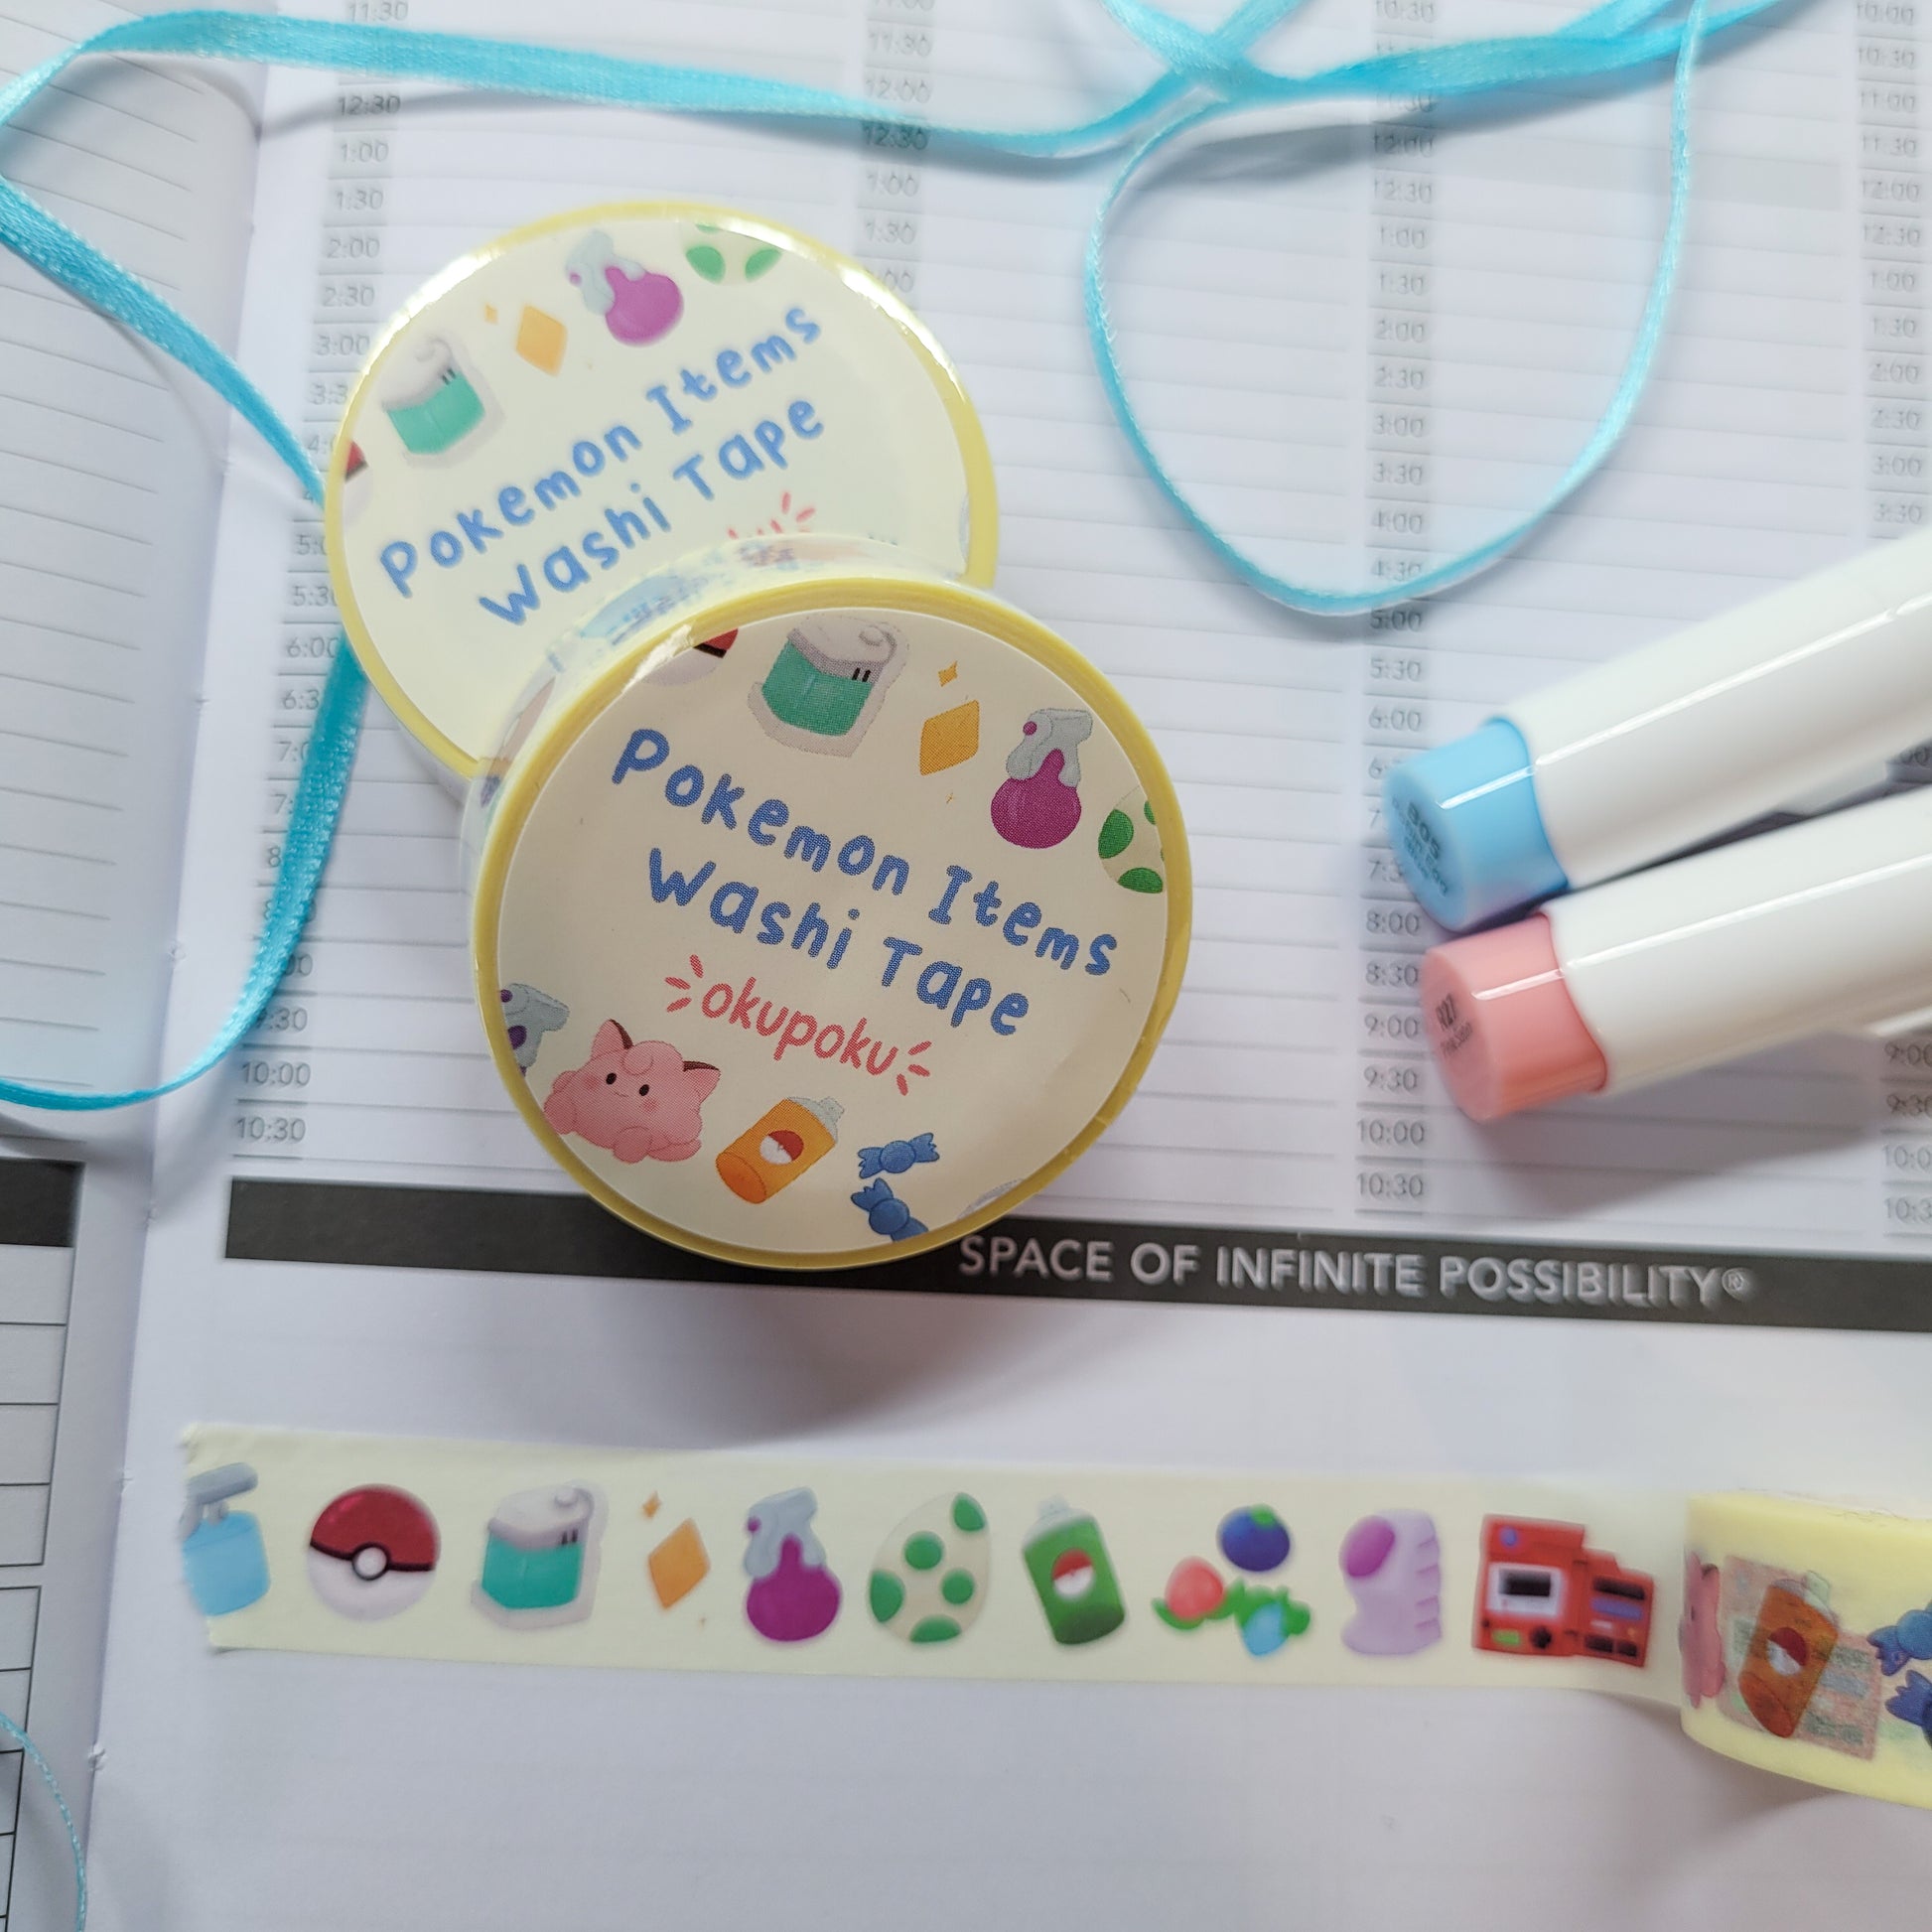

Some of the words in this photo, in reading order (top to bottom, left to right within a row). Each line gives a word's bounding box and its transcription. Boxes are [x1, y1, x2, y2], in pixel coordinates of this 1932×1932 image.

[339, 95, 401, 117] 12:30
[341, 140, 389, 163] 1:00
[335, 189, 384, 210] 1:30
[327, 237, 380, 259] 2:00
[322, 285, 375, 308] 2:30
[1373, 318, 1426, 344] 2:00
[316, 334, 370, 356] 3:00
[1373, 366, 1425, 390] 2:30
[308, 381, 349, 405] 3:3
[1372, 414, 1425, 438] 3:00
[379, 424, 643, 600] Pokemon
[646, 307, 822, 436] Items
[1372, 462, 1424, 485] 3:30
[479, 482, 672, 626] Washi
[672, 399, 825, 501] Tape
[1371, 509, 1423, 534] 4:00
[1370, 608, 1423, 632] 5:00
[1369, 657, 1422, 682] 5:30
[282, 689, 321, 710] 6:3
[1369, 707, 1422, 732] 6:00
[612, 728, 910, 897] Pokemon
[928, 865, 1118, 976] Items
[1366, 911, 1421, 936] 8:00
[648, 848, 860, 970] Washi
[882, 936, 1030, 1035] Tape
[1365, 962, 1419, 988] 8:30
[701, 977, 897, 1076] okupoku
[1364, 1015, 1420, 1039] 9:00
[241, 1060, 311, 1087] 10:00
[1364, 1066, 1418, 1091] 9:30
[235, 1116, 306, 1143] 10:30
[1357, 1118, 1426, 1145] 10:00
[1883, 1145, 1932, 1170] 10:0
[1356, 1172, 1424, 1199] 10:30
[1884, 1197, 1932, 1222] 10:3
[960, 1234, 1115, 1283] SPACE
[1130, 1241, 1201, 1286] OF
[1216, 1246, 1426, 1297] INFINITE
